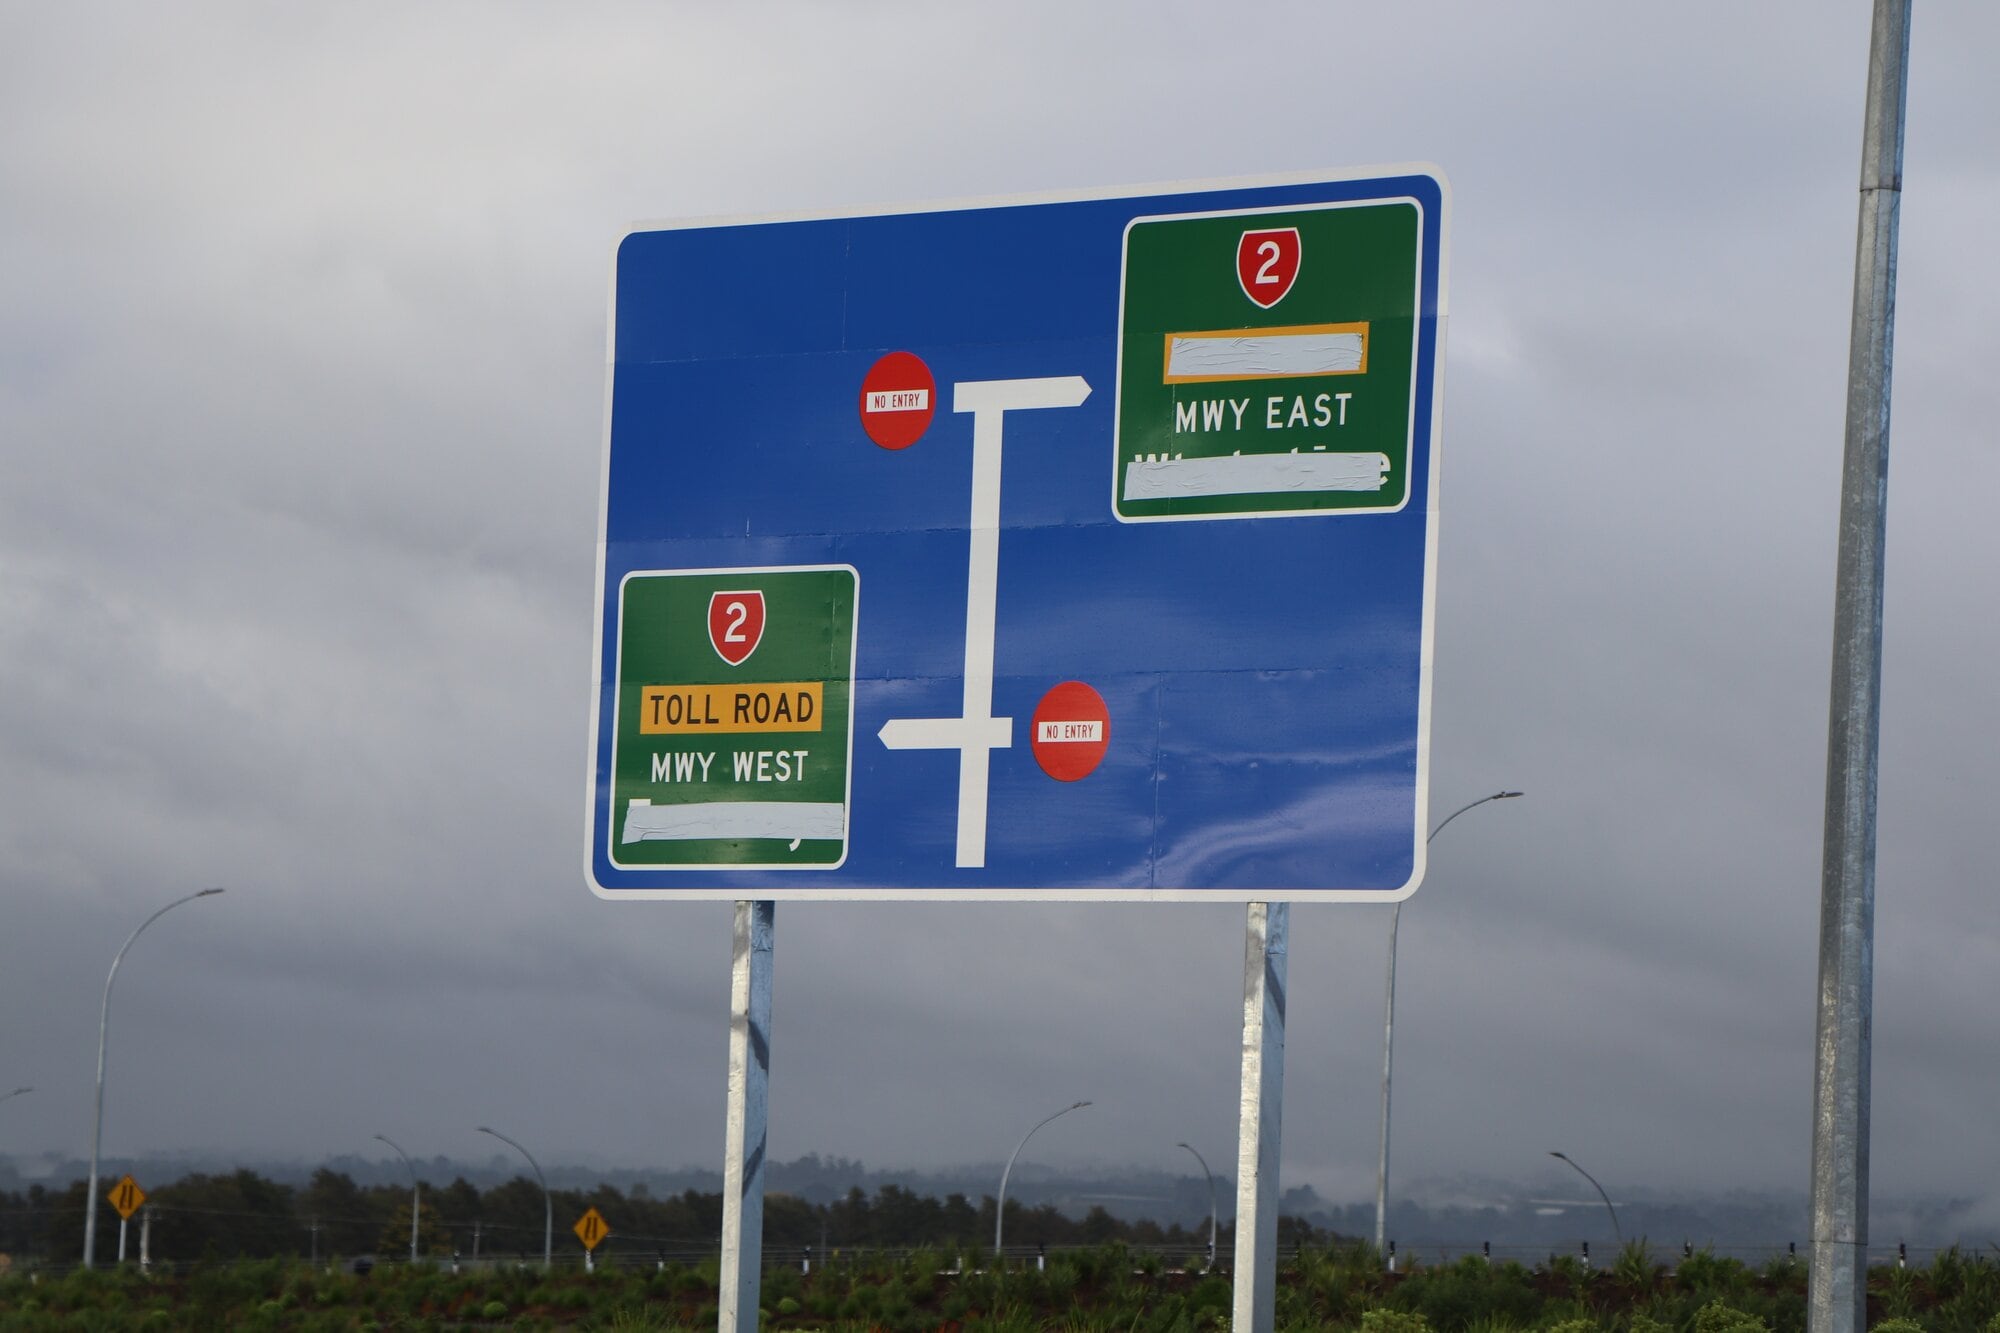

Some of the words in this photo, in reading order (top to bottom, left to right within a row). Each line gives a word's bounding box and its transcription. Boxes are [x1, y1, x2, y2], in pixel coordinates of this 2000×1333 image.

[1255, 241, 1280, 284] 2
[874, 395, 886, 408] NO
[892, 393, 920, 408] ENTRY
[1175, 398, 1250, 433] MWY
[1266, 393, 1352, 429] EAST
[724, 601, 747, 643] 2
[650, 694, 719, 725] TOLL
[734, 692, 814, 723] ROAD
[1046, 725, 1058, 739] NO
[1065, 724, 1093, 739] ENTRY
[651, 752, 716, 783] MWY
[733, 750, 808, 782] WEST
